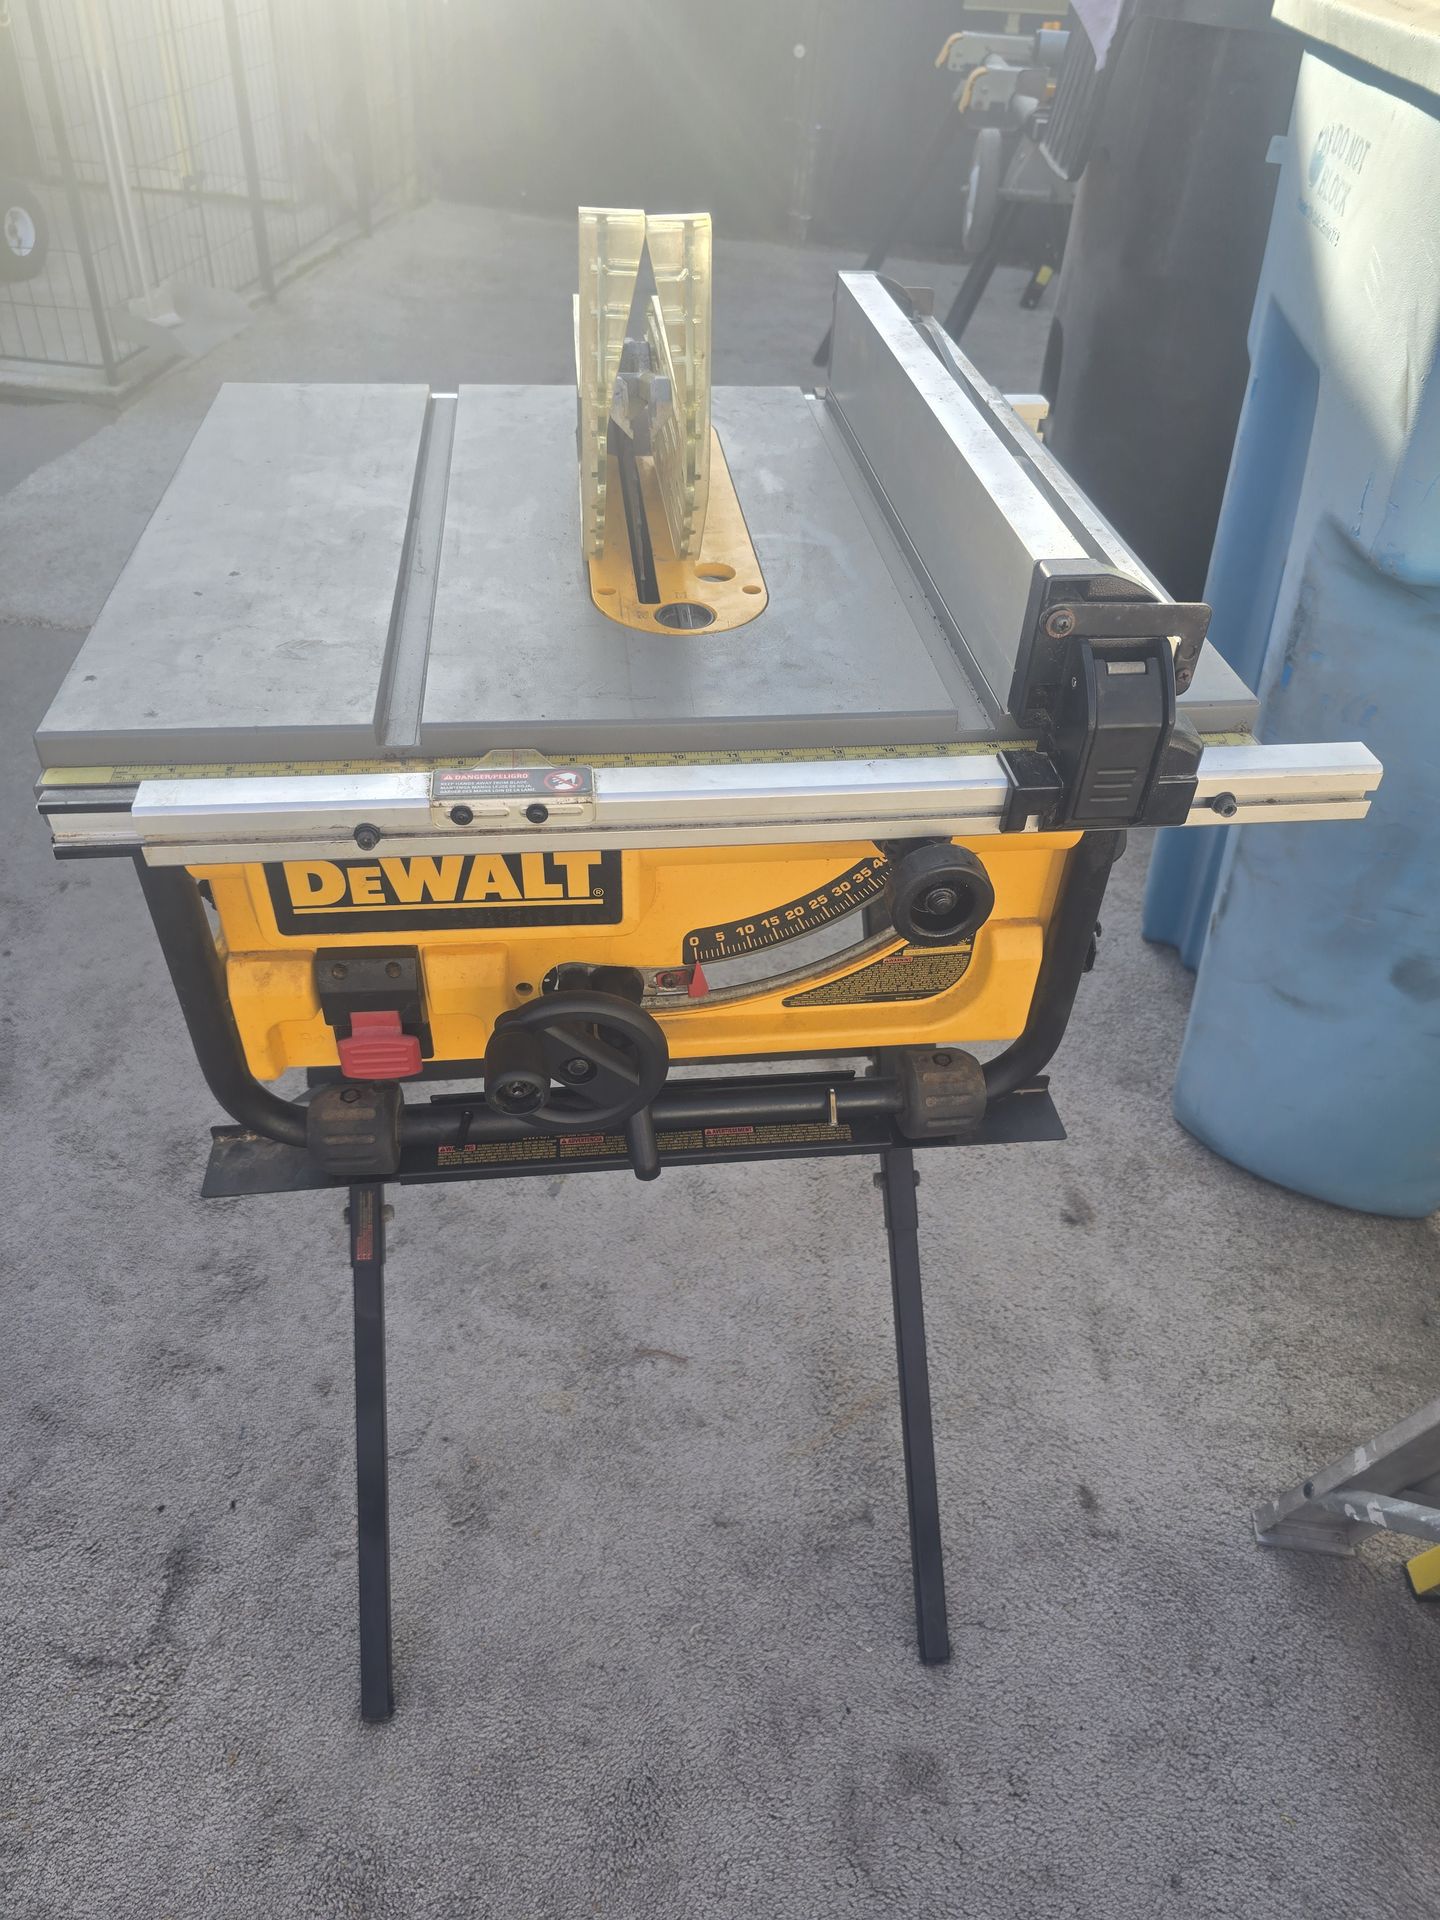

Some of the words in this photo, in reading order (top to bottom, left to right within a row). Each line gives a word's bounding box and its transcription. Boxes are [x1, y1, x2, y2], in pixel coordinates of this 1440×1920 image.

[1345, 135, 1371, 175] NOT
[688, 936, 699, 946] 0
[715, 931, 725, 942] 5
[735, 924, 755, 936] 10
[760, 915, 780, 928] 15
[784, 906, 805, 921] 20
[808, 894, 828, 910] 25
[831, 881, 852, 897] 30
[852, 867, 872, 884] 35
